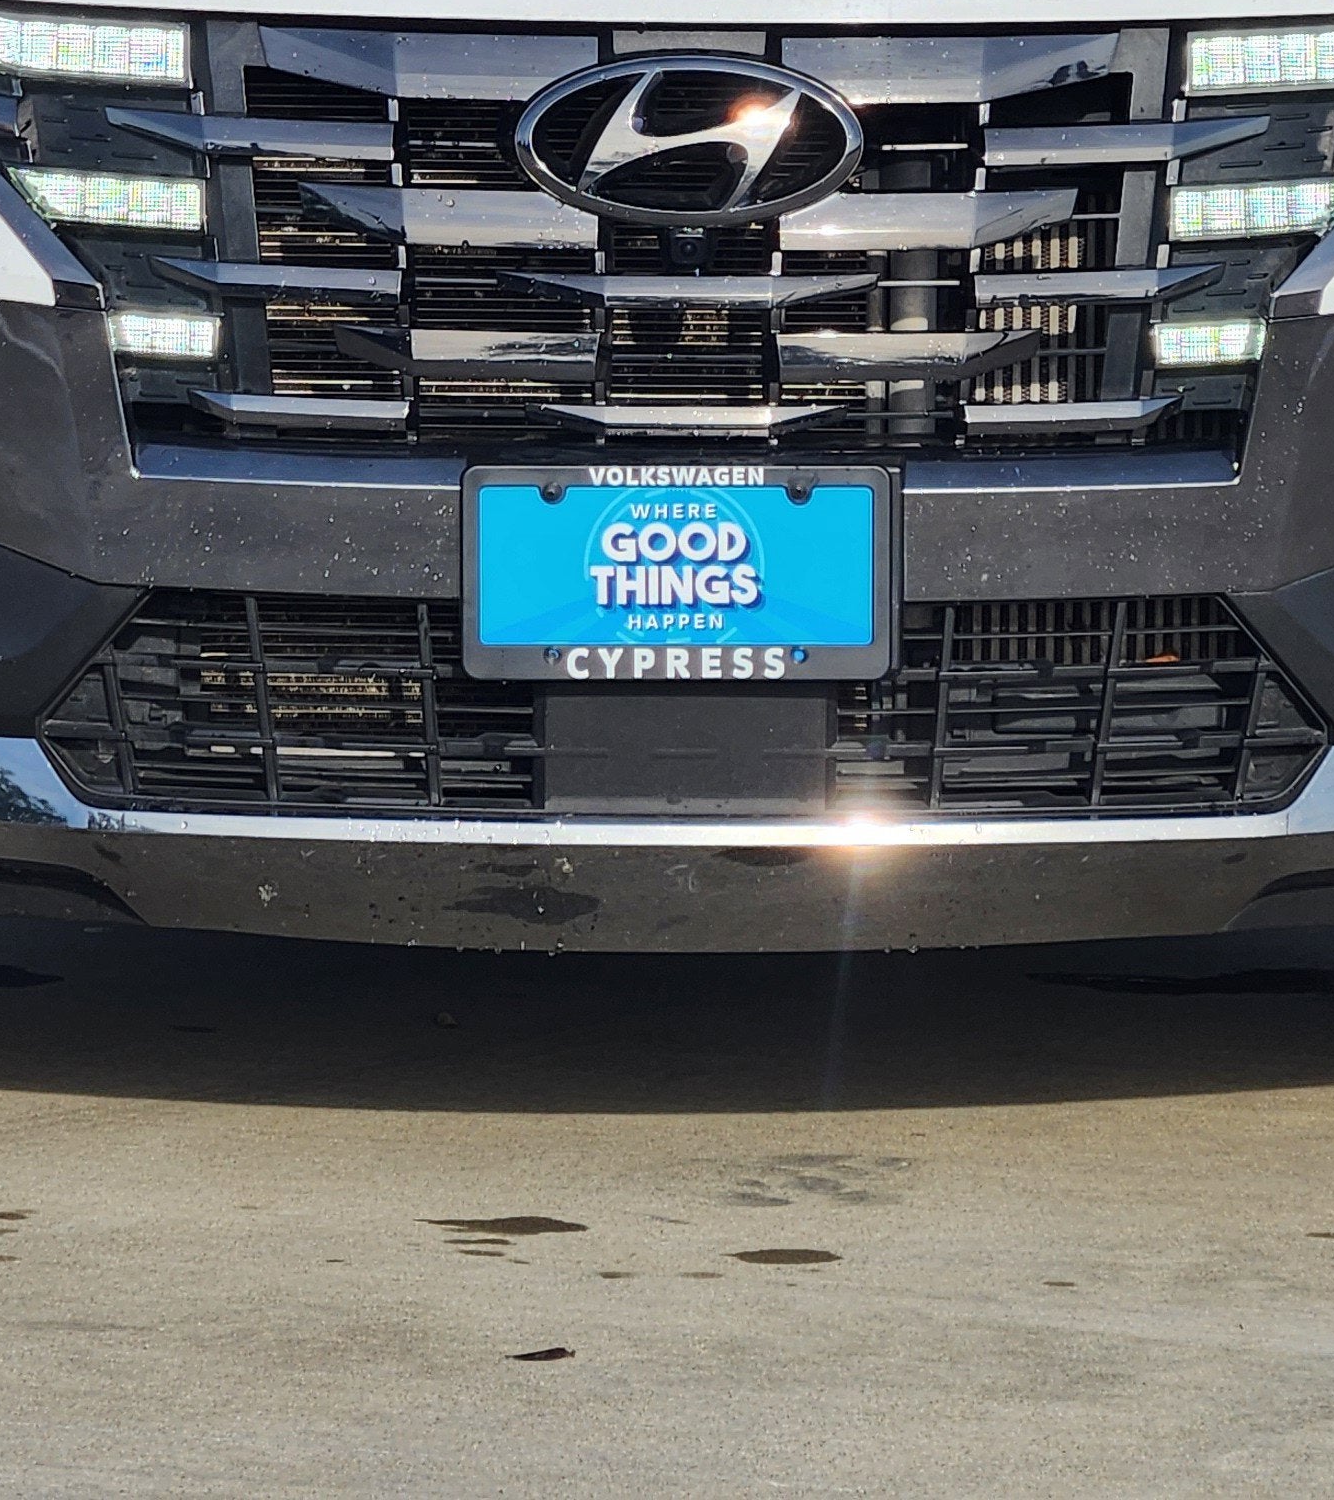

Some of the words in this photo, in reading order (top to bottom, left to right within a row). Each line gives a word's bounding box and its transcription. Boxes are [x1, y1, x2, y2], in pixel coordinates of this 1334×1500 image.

[588, 467, 765, 486] VOLKSWAGEN
[630, 503, 718, 520] WHERE
[601, 522, 748, 562] GOOD
[589, 565, 760, 607] THINGS
[628, 614, 725, 630] HAPPEN
[567, 647, 786, 679] CYPRESS
